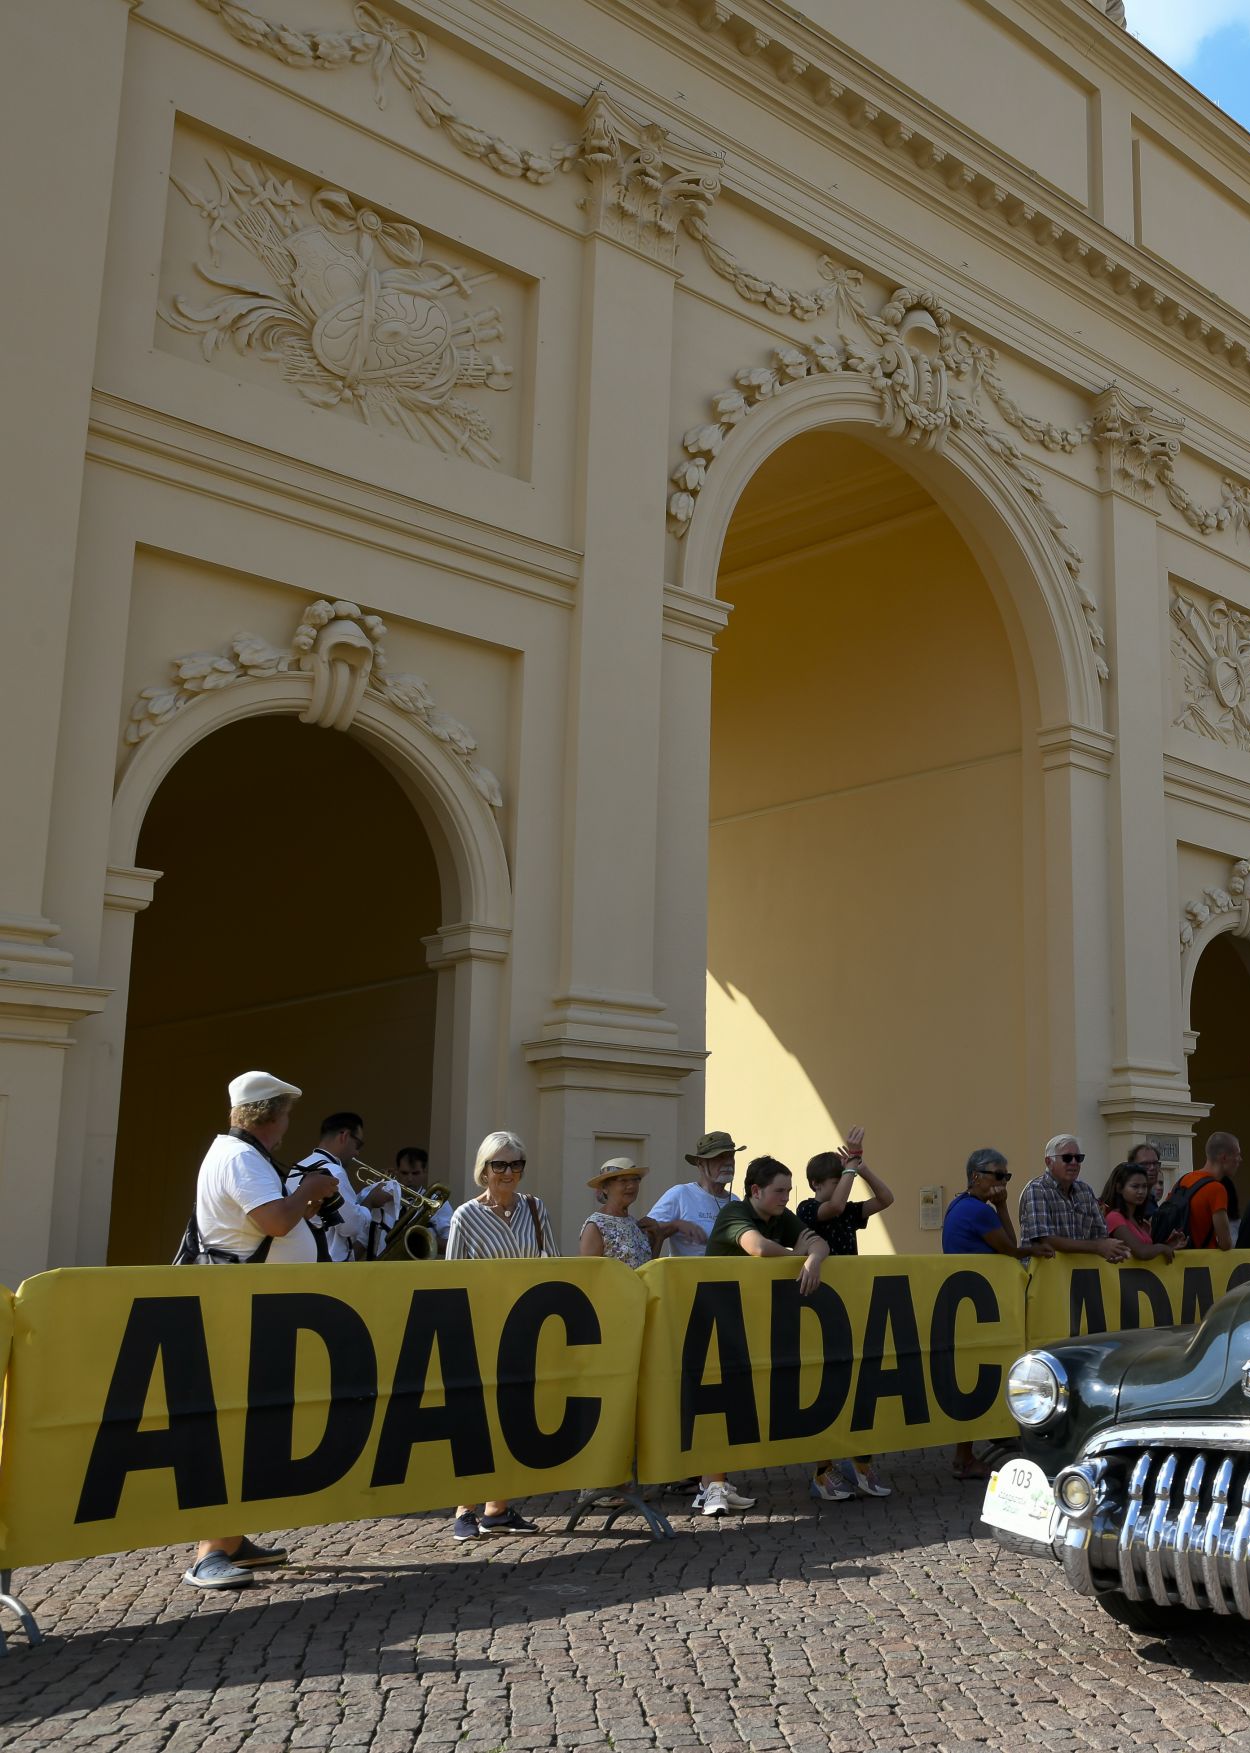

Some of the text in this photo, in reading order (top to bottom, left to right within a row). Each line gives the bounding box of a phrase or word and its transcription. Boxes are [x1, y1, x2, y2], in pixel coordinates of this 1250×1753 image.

[73, 1281, 602, 1524] ADAC
[680, 1270, 1001, 1452] ADAC
[1011, 1468, 1032, 1488] 103
